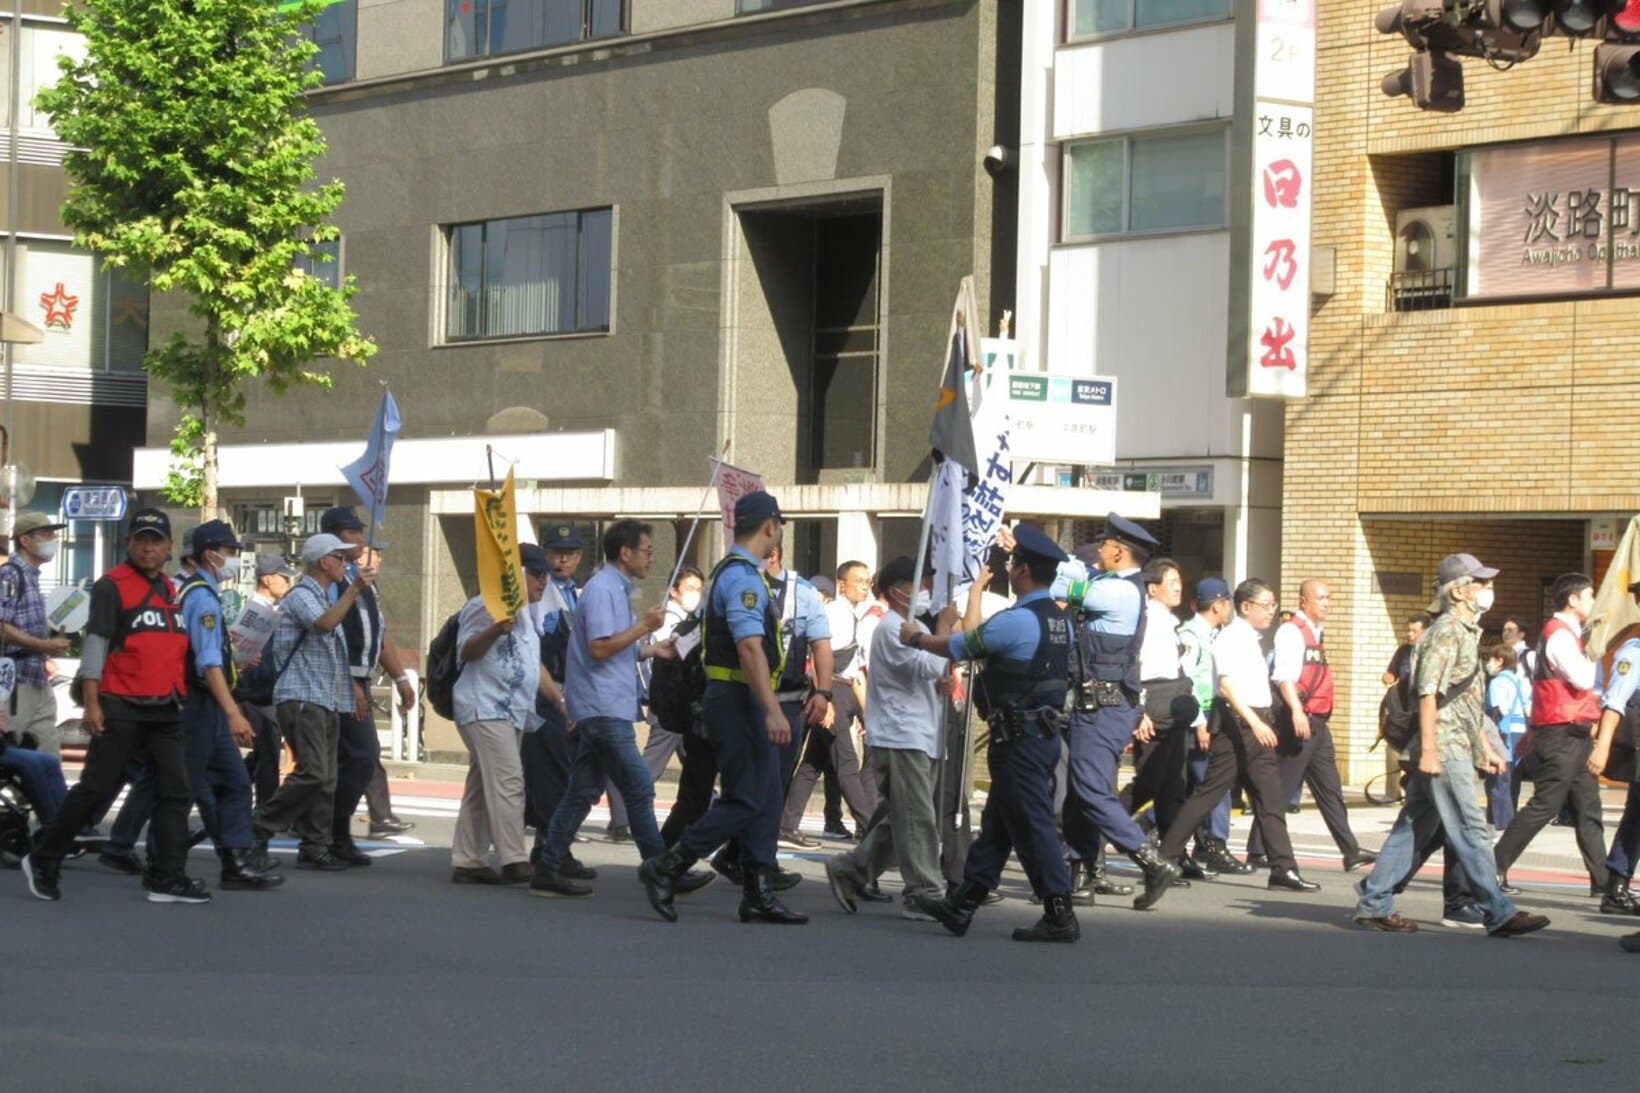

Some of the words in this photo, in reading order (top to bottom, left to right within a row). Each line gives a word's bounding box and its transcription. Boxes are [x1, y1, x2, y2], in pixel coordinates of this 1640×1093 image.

[1257, 114, 1311, 140] 文具の
[1523, 187, 1640, 242] 淡路町
[1260, 159, 1302, 371] 日乃出
